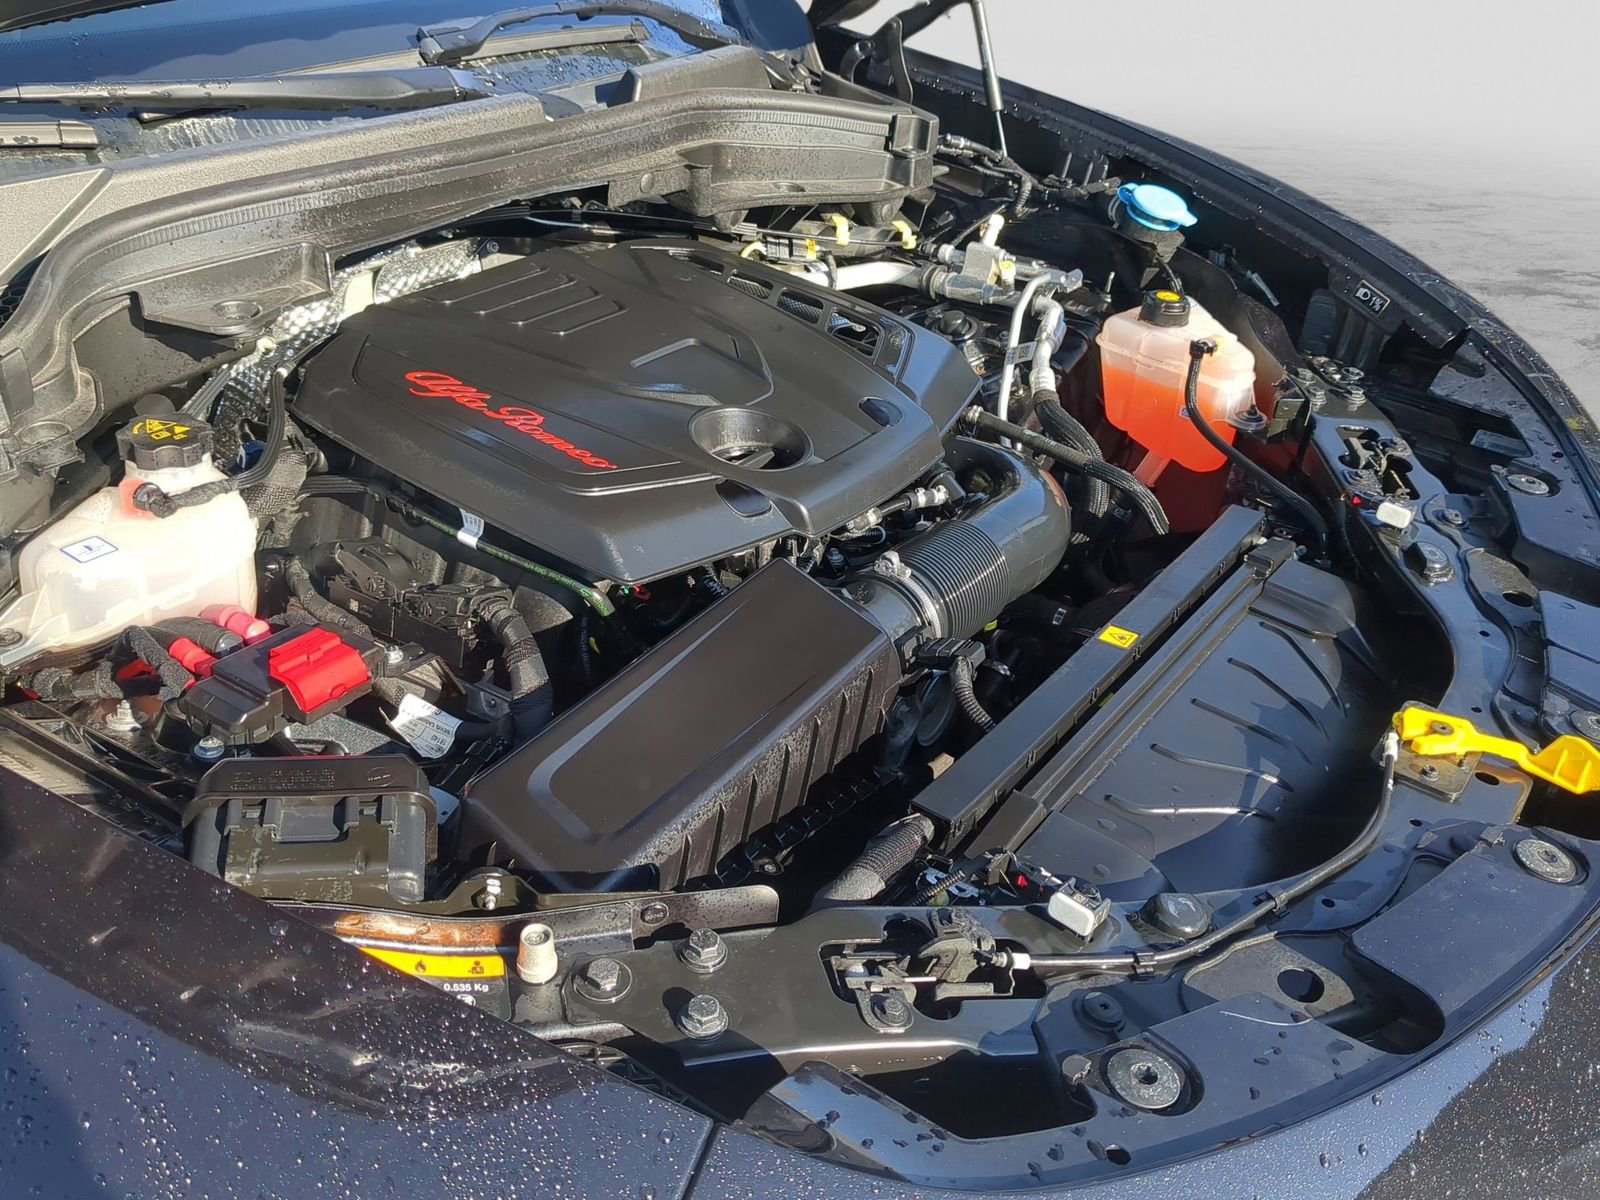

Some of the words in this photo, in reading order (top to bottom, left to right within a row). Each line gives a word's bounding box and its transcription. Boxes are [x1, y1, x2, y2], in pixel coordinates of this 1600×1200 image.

[404, 370, 492, 410] Alfa
[483, 406, 618, 469] Romeo
[474, 983, 489, 993] Kg
